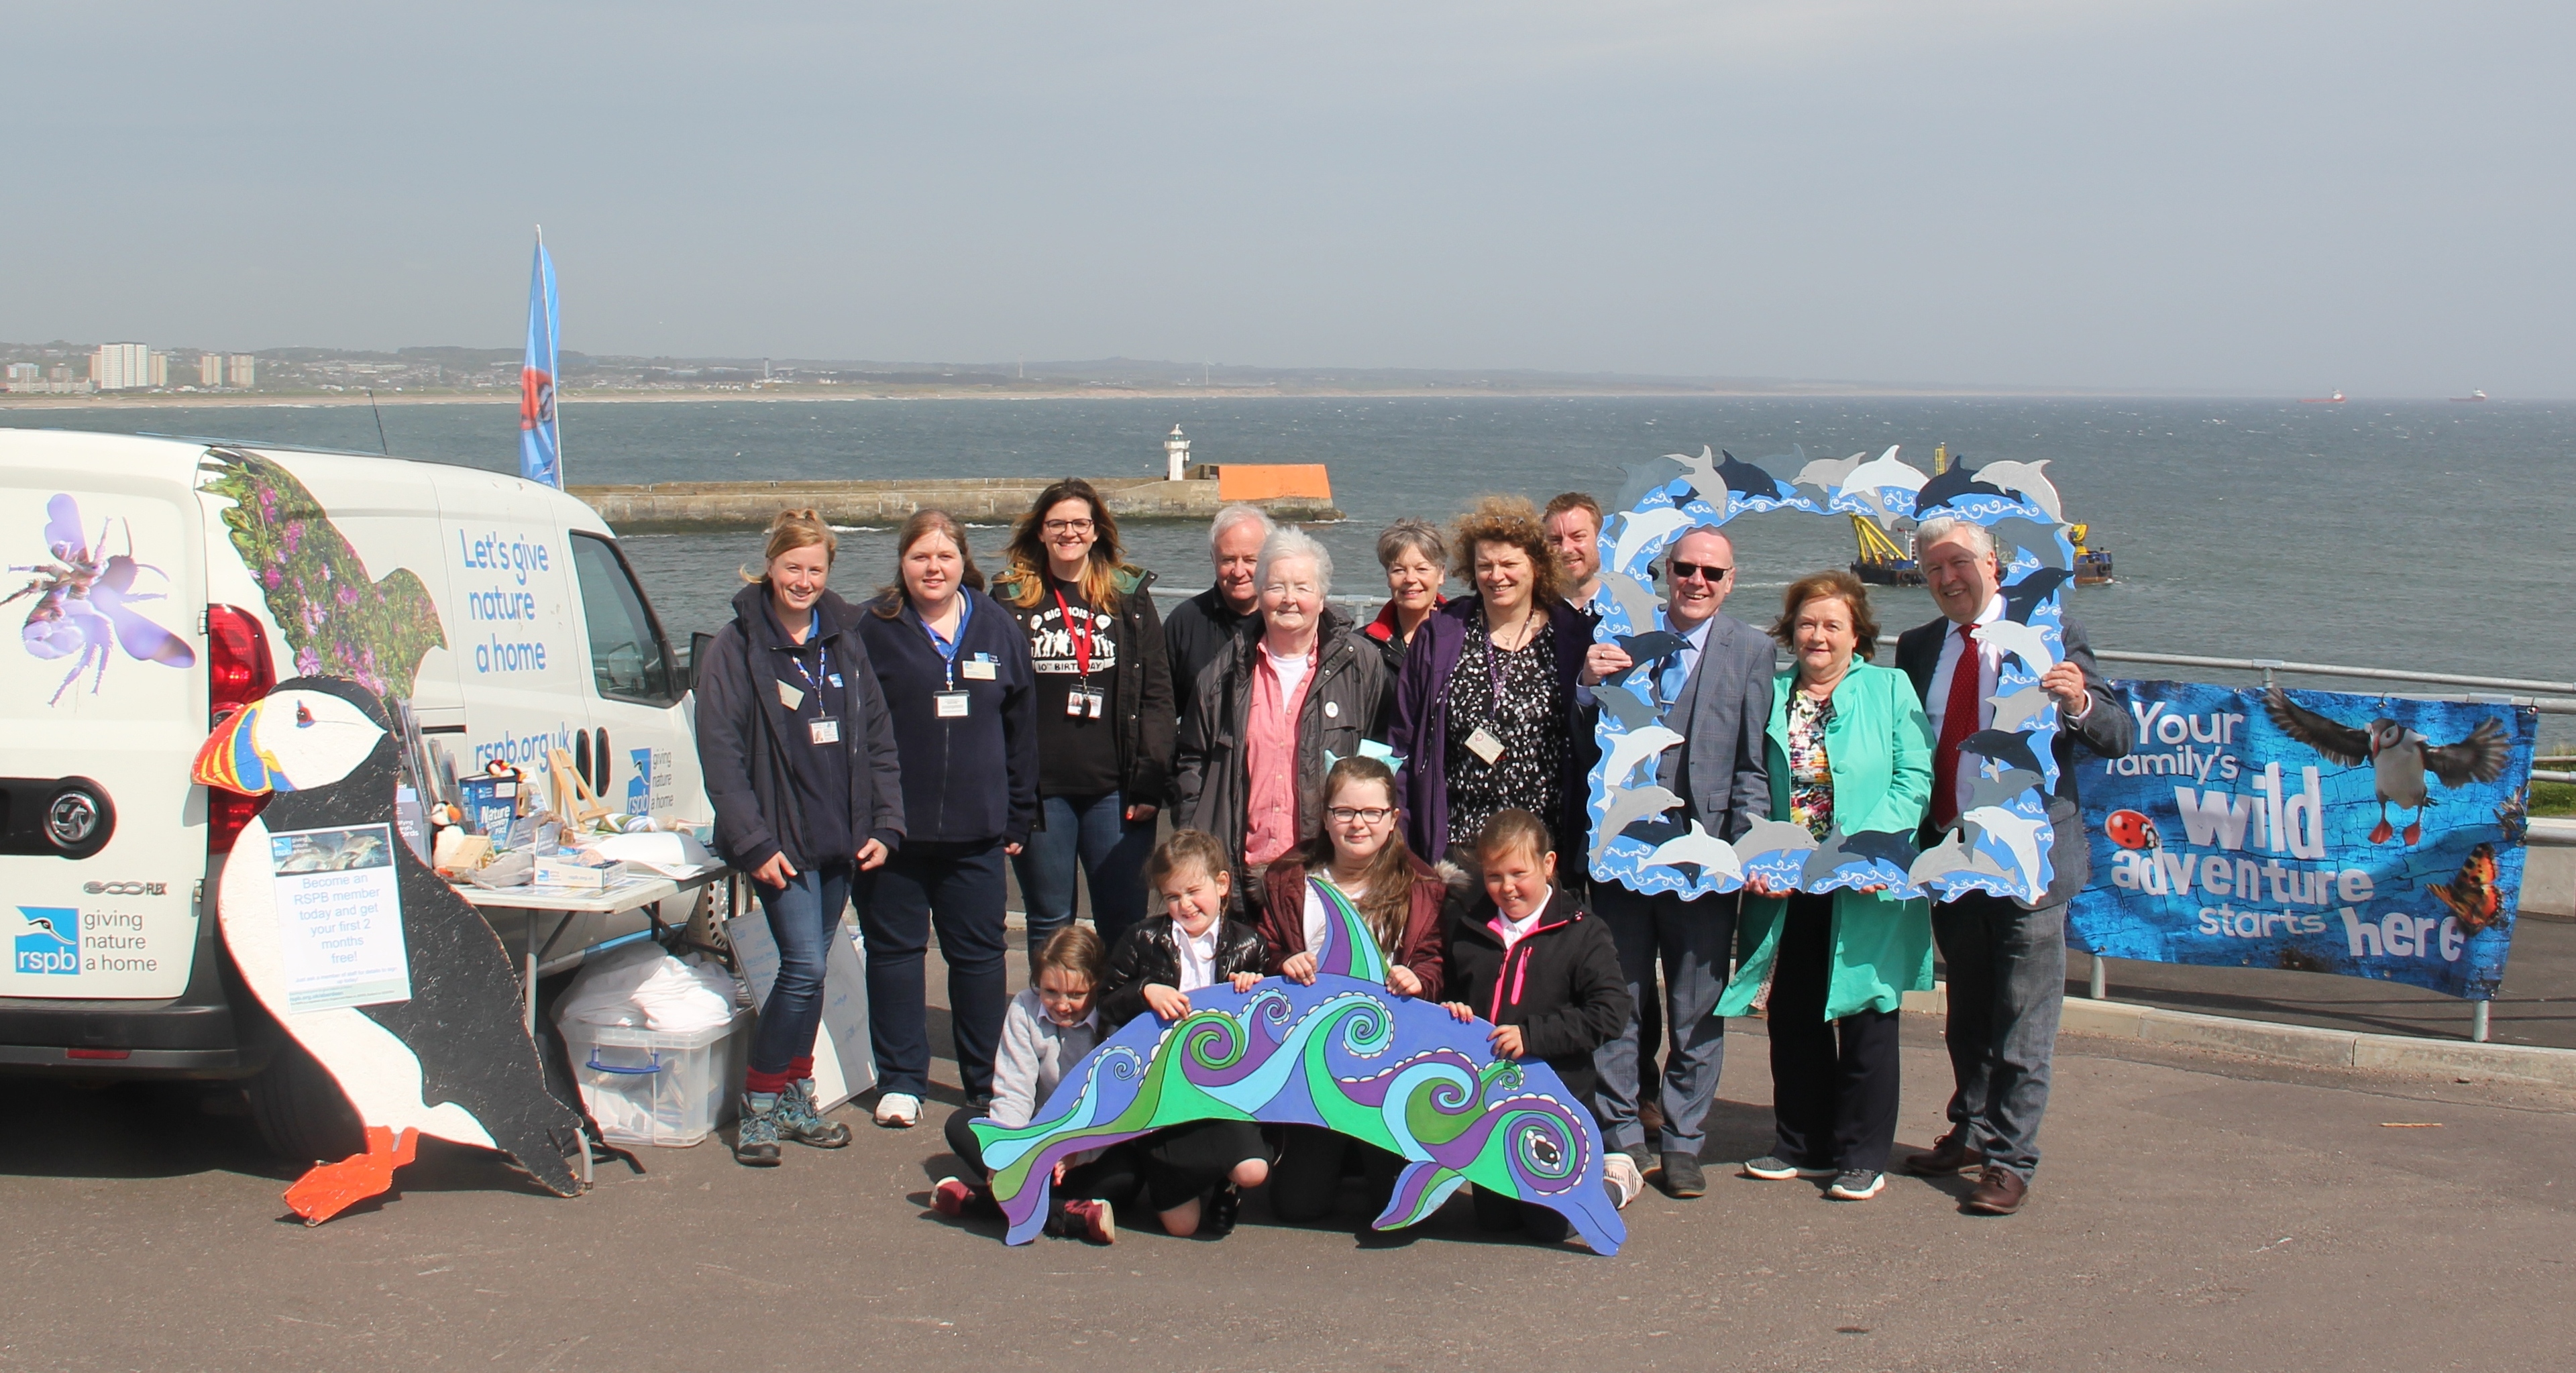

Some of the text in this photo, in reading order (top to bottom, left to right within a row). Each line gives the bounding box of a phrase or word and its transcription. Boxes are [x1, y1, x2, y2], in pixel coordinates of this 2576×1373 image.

[460, 529, 549, 586] Let's give
[470, 586, 535, 621] nature
[1044, 608, 1061, 621] BIG
[476, 633, 546, 673] a home
[1055, 663, 1101, 671] BIRTAY
[2131, 701, 2244, 744] Your
[476, 721, 571, 773] rspb.orguk
[653, 749, 672, 769] giving
[653, 774, 672, 787] nature
[629, 788, 649, 816] rspb
[651, 793, 674, 809] a home
[2174, 761, 2325, 859] wild
[481, 806, 511, 824] Nature
[303, 875, 368, 889] Become an
[2111, 848, 2374, 904] adventure
[294, 888, 380, 905] RSPB member
[84, 910, 143, 931] giving
[299, 902, 378, 921] today and get
[310, 918, 371, 938] your first 2
[2198, 903, 2465, 961] starts here
[85, 934, 146, 949] nature
[321, 936, 365, 949] months
[19, 946, 76, 975] rspb
[85, 954, 158, 971] a home
[331, 950, 358, 964] free!
